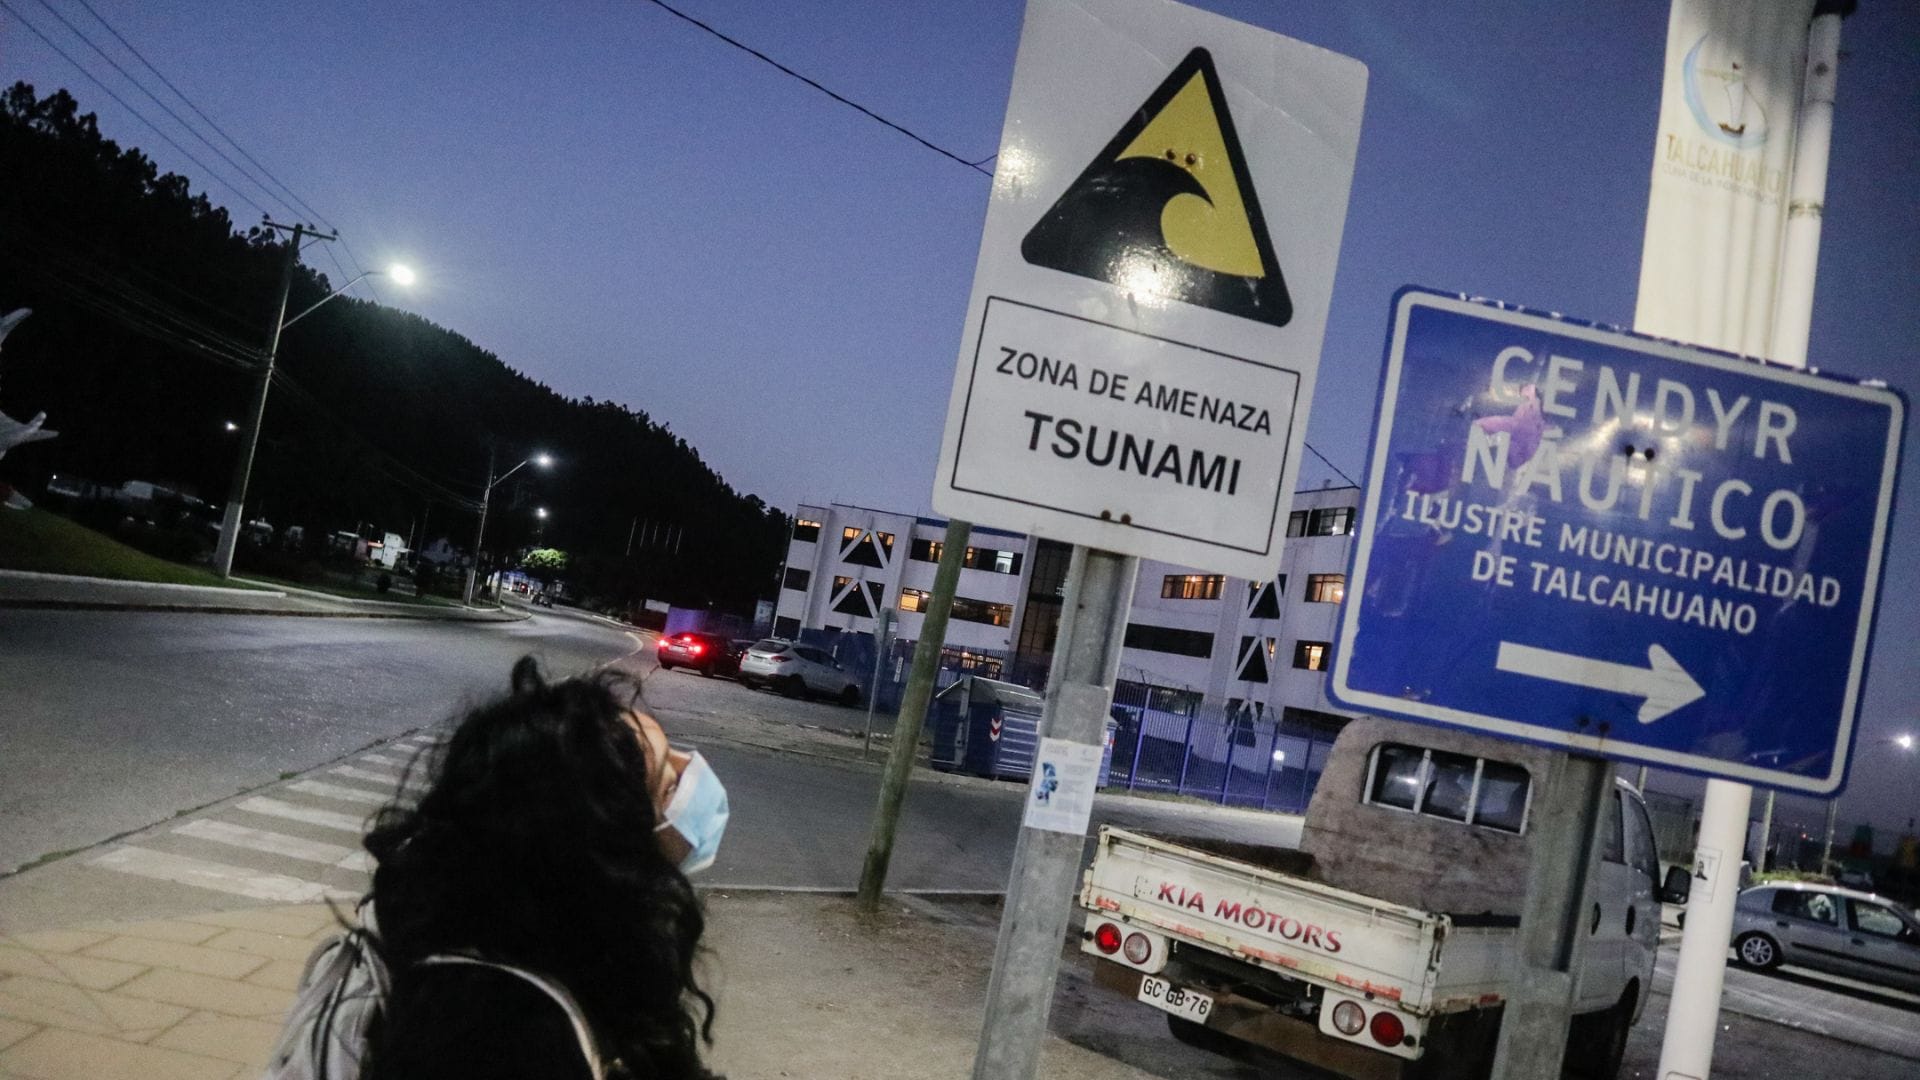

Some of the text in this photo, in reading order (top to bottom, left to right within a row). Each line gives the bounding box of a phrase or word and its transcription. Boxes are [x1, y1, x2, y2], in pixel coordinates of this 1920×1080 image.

[996, 346, 1271, 435] ZONA DE AMENAZA
[1491, 345, 1798, 464] CENDYR
[1024, 410, 1242, 496] TSUNAMI
[1461, 424, 1806, 550] NÁUTICO
[1402, 491, 1841, 608] ILUSTRE MUNICIPALIDAD
[1472, 550, 1757, 635] DE TALCAHUANO
[1158, 881, 1343, 953] KIA MOTORS
